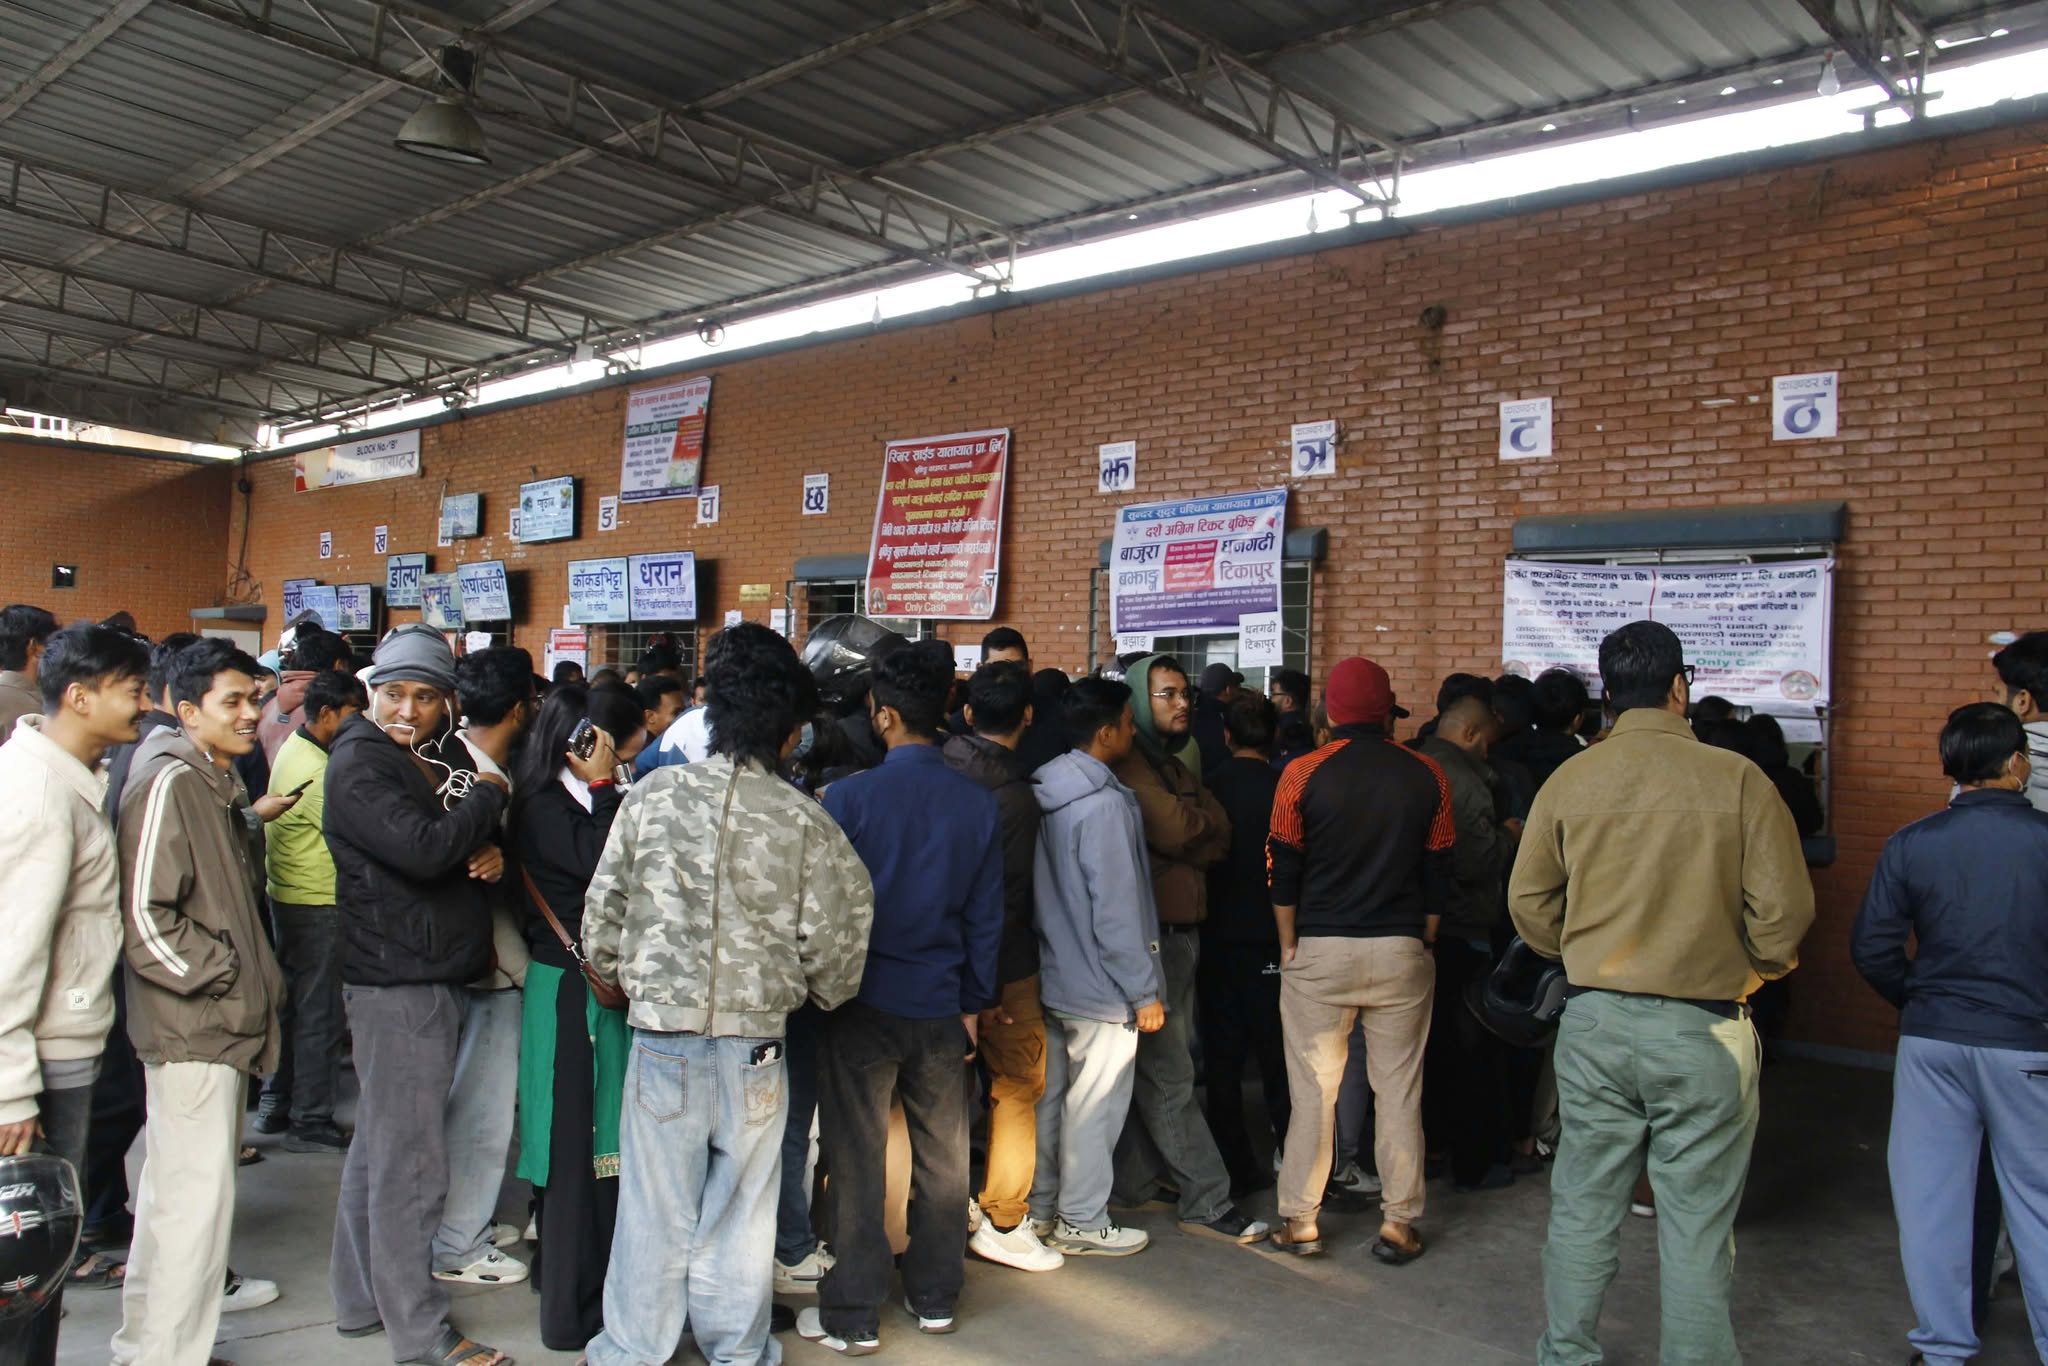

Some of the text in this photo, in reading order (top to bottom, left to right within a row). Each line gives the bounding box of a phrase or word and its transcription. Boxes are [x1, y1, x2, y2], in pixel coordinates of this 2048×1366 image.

[1783, 392, 1827, 435] ठ
[1510, 415, 1541, 452] ट
[356, 442, 378, 456] BLOCK
[937, 444, 974, 458] यातायात
[1296, 437, 1329, 472] ञ
[701, 497, 716, 519] च
[805, 486, 826, 511] छ
[1127, 510, 1153, 520] सुन्दर
[1180, 502, 1209, 514] पश्चिम
[1211, 499, 1251, 511] यातायात
[1165, 520, 1194, 537] अग्रिम
[1198, 518, 1225, 532] टिकट
[320, 540, 331, 557] क
[375, 533, 386, 552] ख
[1120, 544, 1161, 564] बाजुरा
[1221, 531, 1275, 553] धनगढी
[390, 557, 423, 588] डोल्पा
[460, 568, 505, 594] अर्घाखाँची
[640, 560, 683, 587] धरान
[1219, 560, 1276, 583] टिकापुर
[1581, 571, 1617, 580] यातायात
[1695, 571, 1737, 580] यातायात
[1778, 569, 1817, 580] धनगढी
[339, 590, 358, 614] सुर्खेत
[905, 602, 946, 613] Only Cash
[1245, 620, 1277, 634] धनगढी
[1245, 638, 1277, 654] टिकापुर
[1695, 658, 1730, 668] Only
